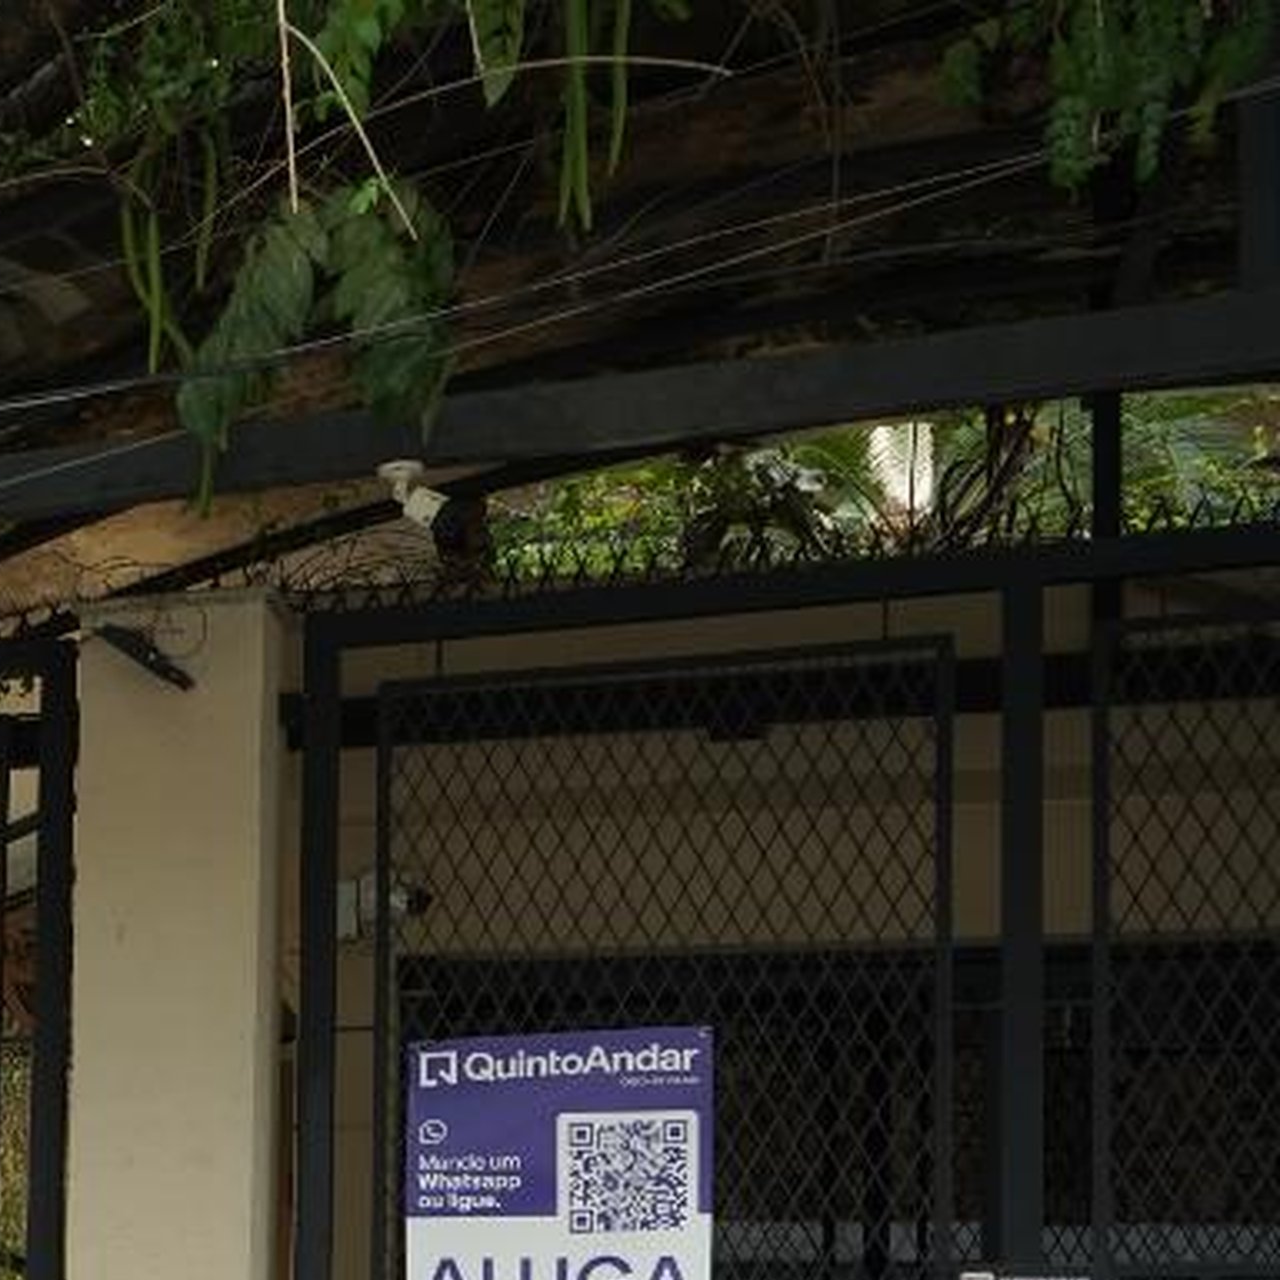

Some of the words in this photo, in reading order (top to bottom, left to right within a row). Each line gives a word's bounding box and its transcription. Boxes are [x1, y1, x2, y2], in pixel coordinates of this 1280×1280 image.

[463, 1044, 700, 1082] QuintoAndar
[488, 1155, 521, 1171] um
[418, 1195, 444, 1208] ou
